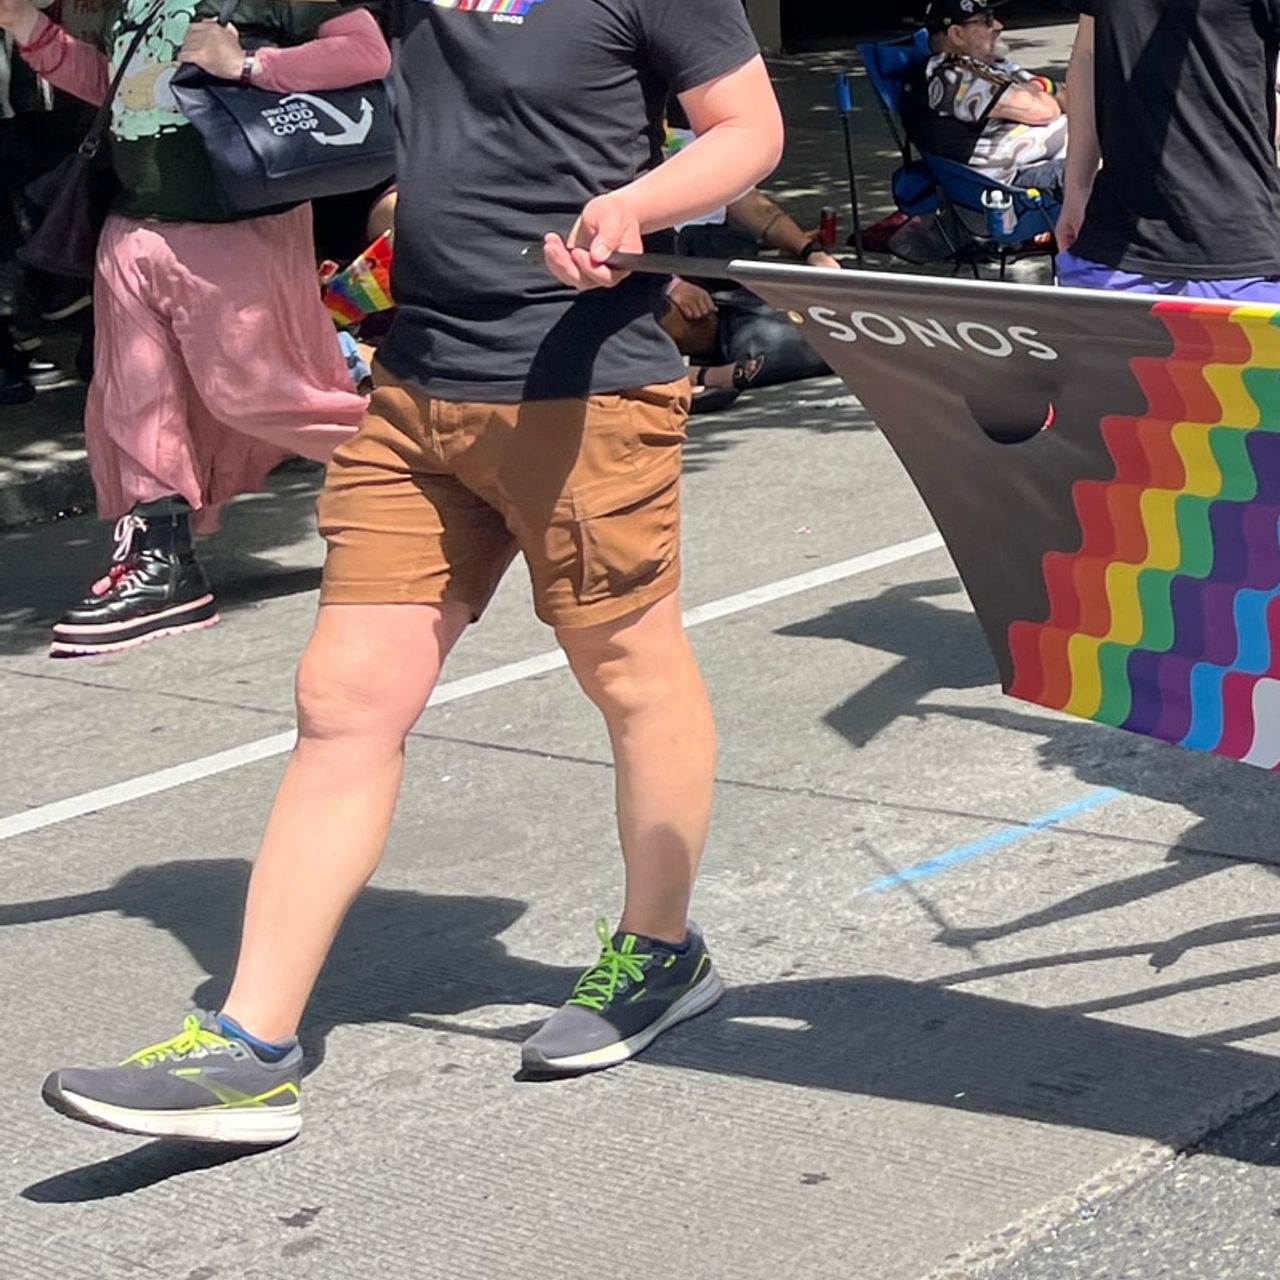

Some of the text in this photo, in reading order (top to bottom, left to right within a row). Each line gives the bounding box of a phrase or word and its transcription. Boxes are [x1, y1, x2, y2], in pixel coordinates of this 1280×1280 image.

[492, 13, 523, 25] SONOS
[267, 108, 315, 127] FOOD
[273, 118, 319, 136] CO-OP
[808, 306, 1059, 361] SONOS
